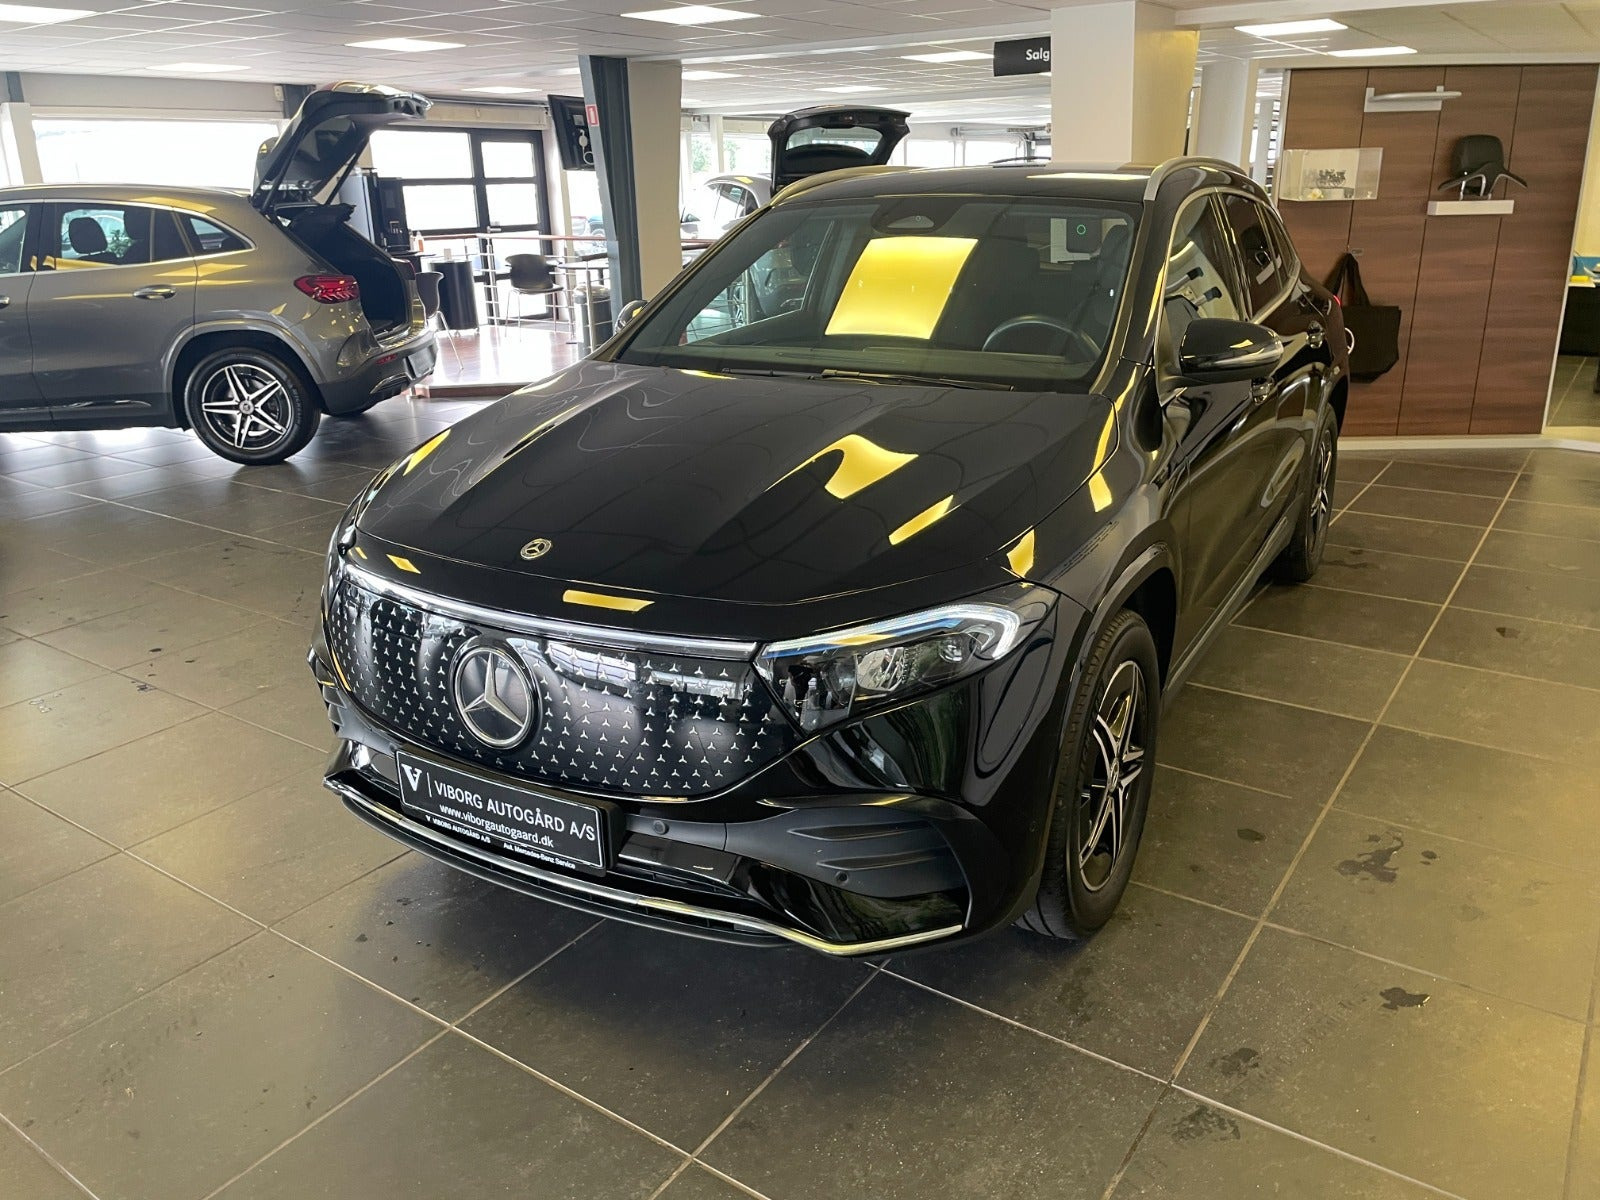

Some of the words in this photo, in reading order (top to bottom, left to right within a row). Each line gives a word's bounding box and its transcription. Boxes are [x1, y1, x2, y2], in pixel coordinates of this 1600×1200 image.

[1025, 47, 1050, 62] Salg
[434, 780, 483, 809] VIBORG
[487, 798, 565, 831] AUTOGÅRD
[569, 821, 596, 841] A/S
[439, 804, 555, 848] www.viborgautogaard.dk
